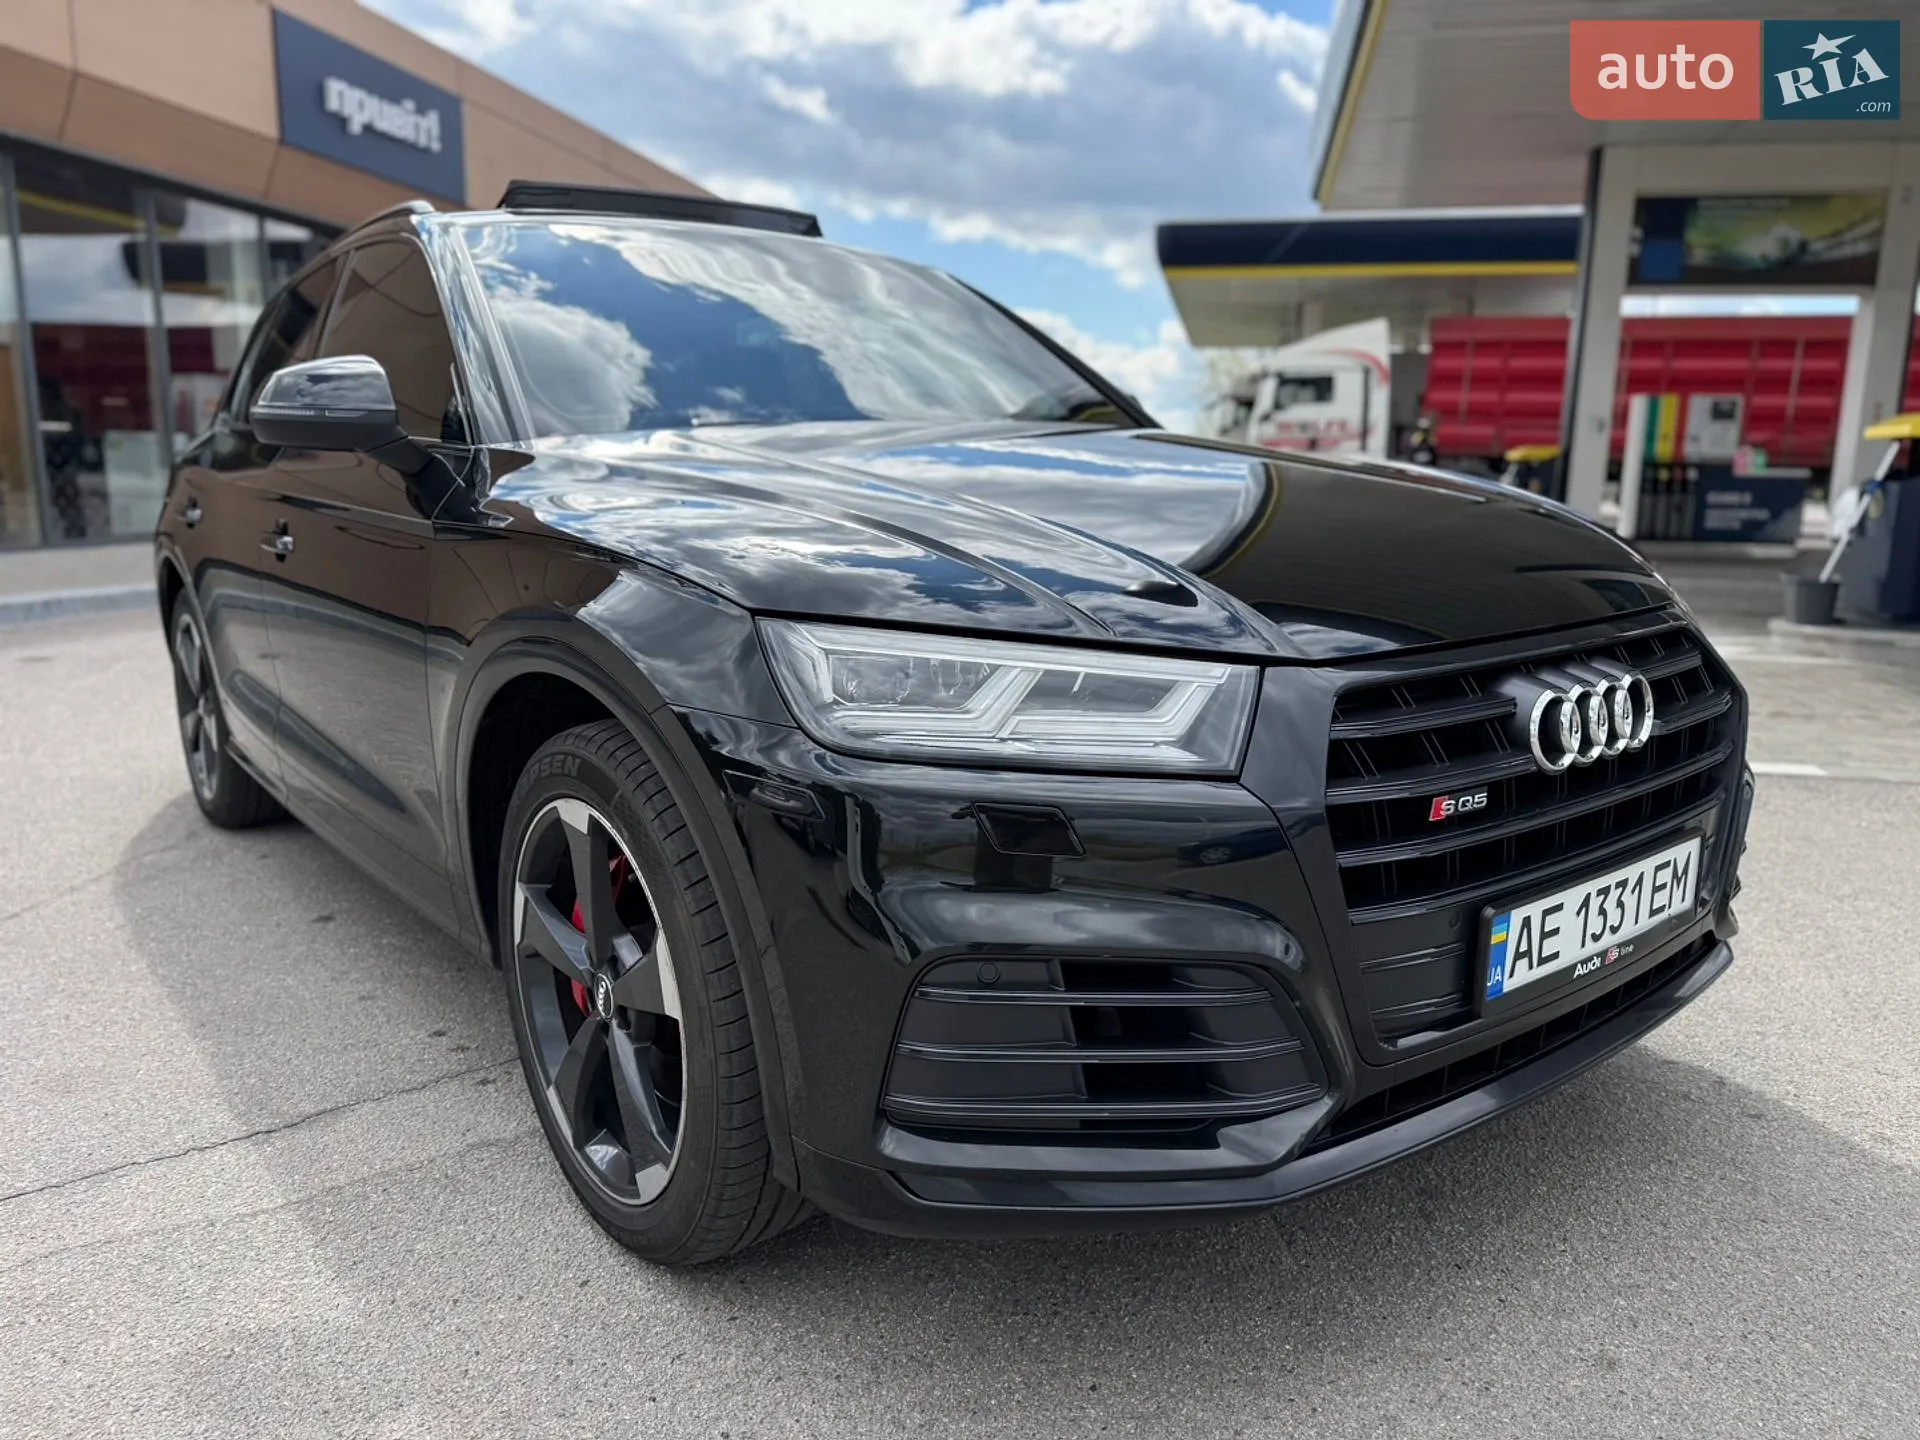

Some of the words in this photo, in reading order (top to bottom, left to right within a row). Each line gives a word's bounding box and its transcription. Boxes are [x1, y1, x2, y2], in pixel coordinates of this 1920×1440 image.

[1508, 902, 1565, 980] AE
[1576, 871, 1646, 949] 1331
[1648, 851, 1692, 919] EM
[1573, 956, 1602, 979] Audi
